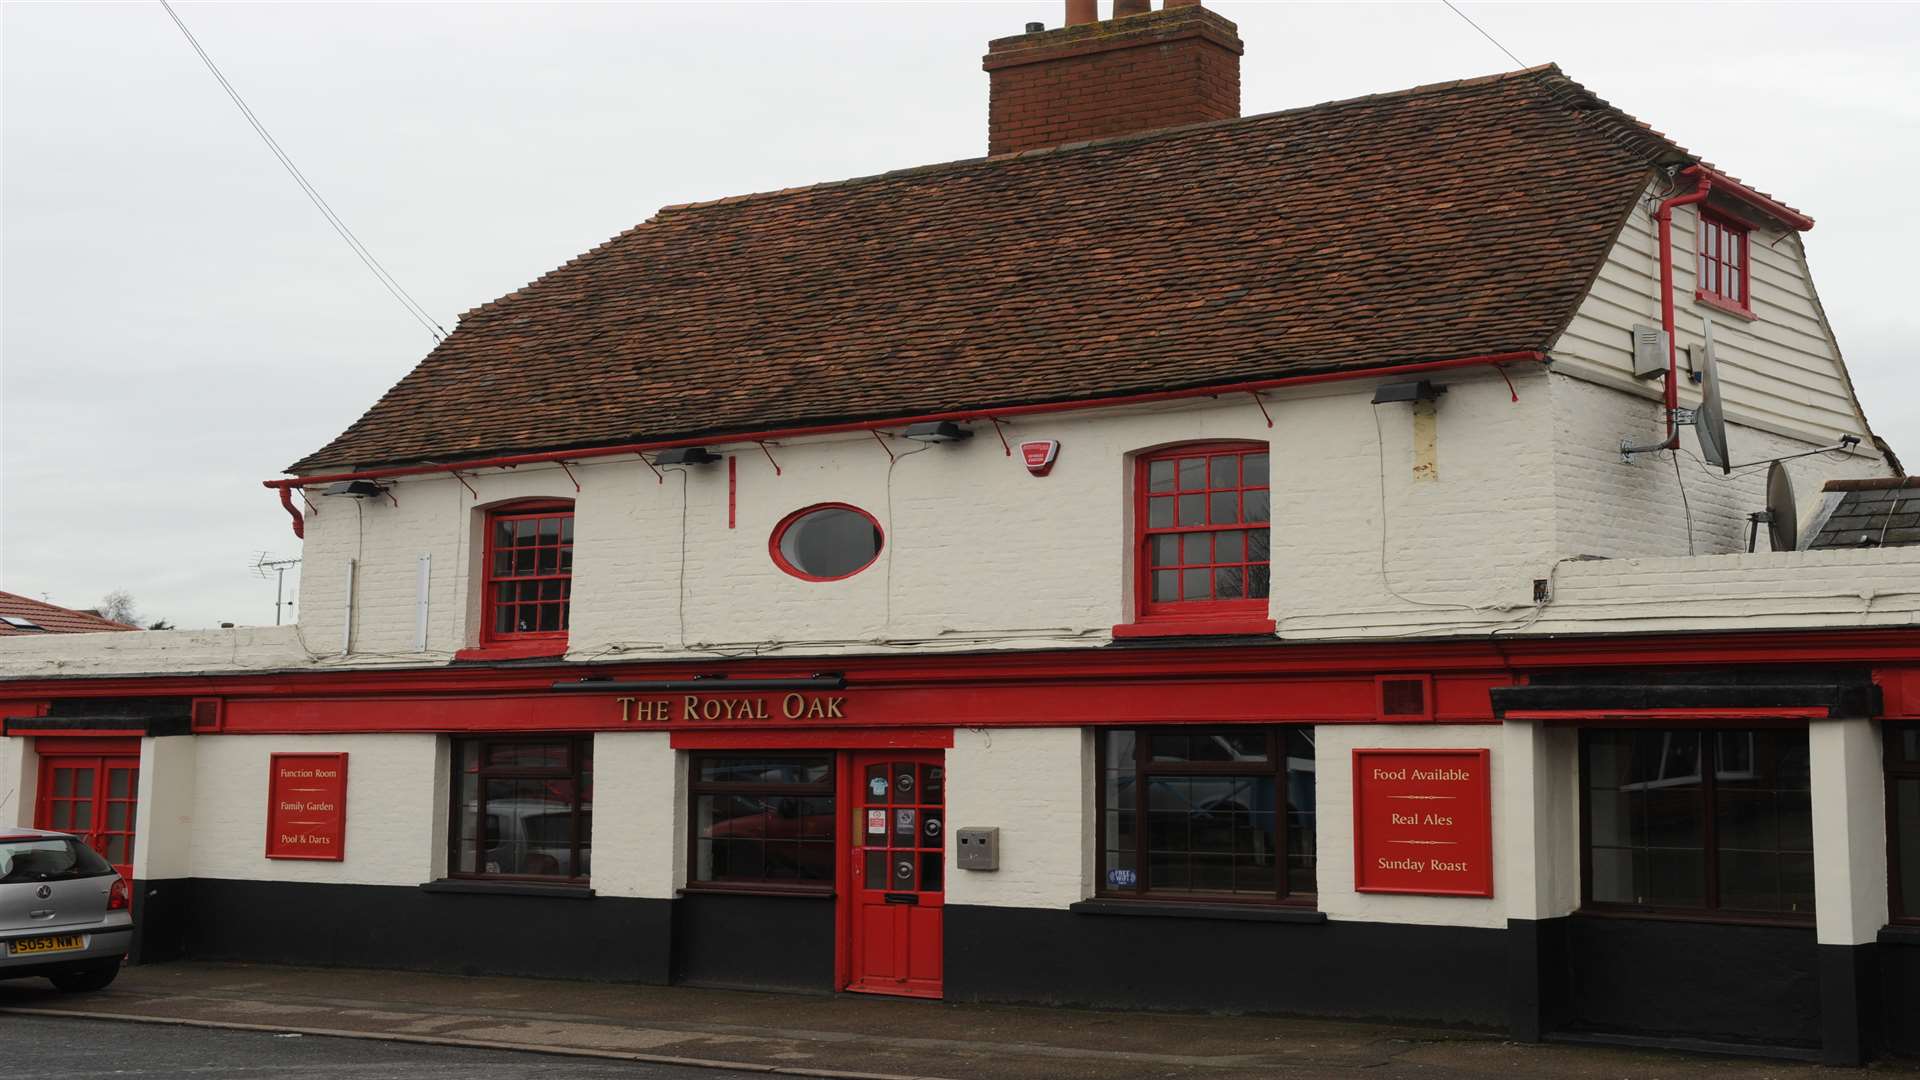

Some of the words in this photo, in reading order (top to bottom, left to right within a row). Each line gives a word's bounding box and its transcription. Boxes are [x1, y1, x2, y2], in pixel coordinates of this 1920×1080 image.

[617, 696, 670, 721] THE
[683, 695, 769, 720] ROYAL
[782, 692, 844, 719] OAK
[280, 768, 313, 778] Function
[315, 768, 337, 778] Room
[1373, 768, 1406, 780] Food
[1411, 768, 1470, 781] Available
[280, 801, 305, 812] Family
[306, 801, 334, 811] Garden
[1392, 813, 1419, 825] Real
[1423, 813, 1453, 826] Ales
[281, 834, 298, 844] Pool
[299, 834, 306, 844] &
[309, 834, 330, 845] Darts
[1378, 857, 1425, 873] Sunday
[1431, 859, 1468, 872] Roast
